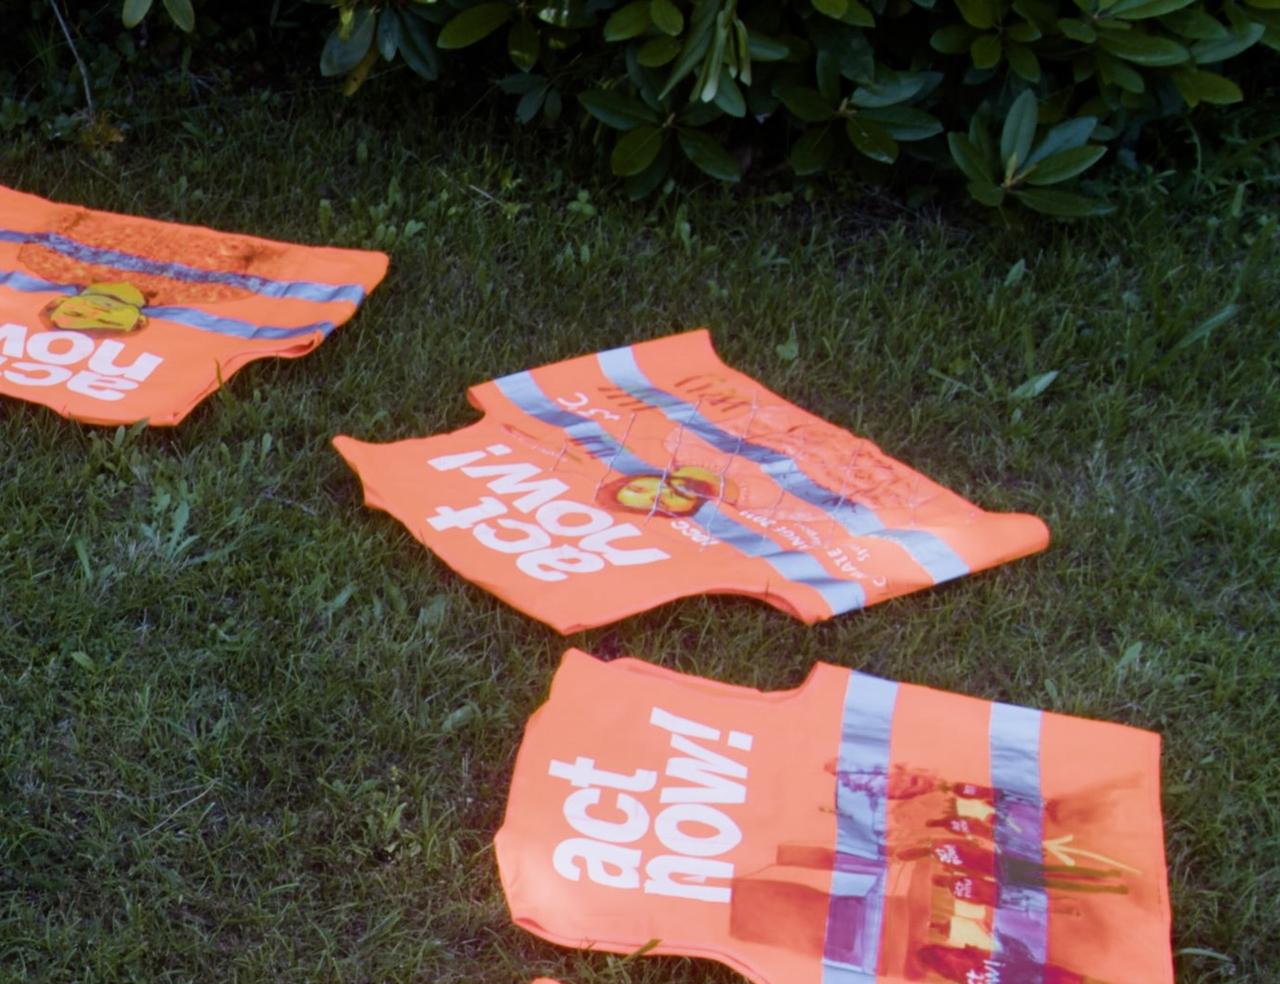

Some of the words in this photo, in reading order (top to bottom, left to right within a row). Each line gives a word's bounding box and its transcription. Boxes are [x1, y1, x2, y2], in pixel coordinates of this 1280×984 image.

[426, 443, 670, 569] now!
[426, 495, 605, 583] act
[548, 755, 657, 890] act
[643, 707, 754, 903] now!
